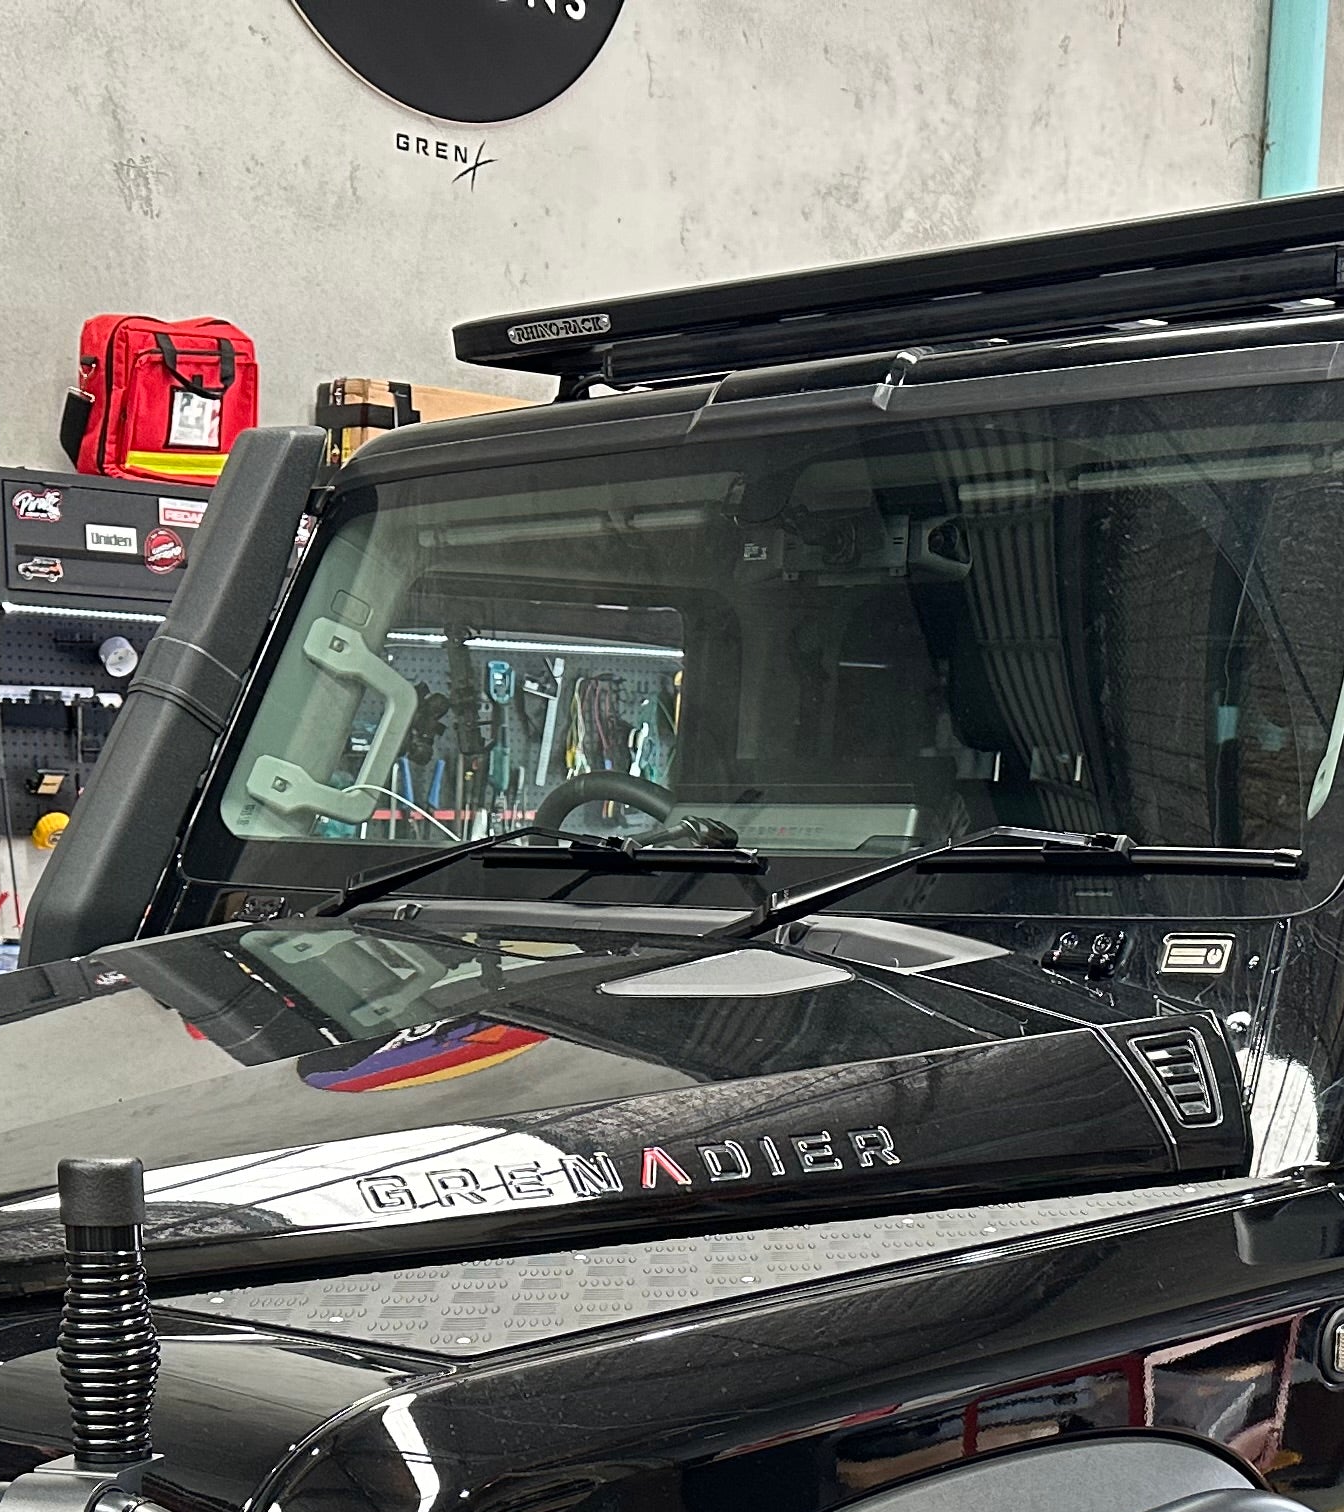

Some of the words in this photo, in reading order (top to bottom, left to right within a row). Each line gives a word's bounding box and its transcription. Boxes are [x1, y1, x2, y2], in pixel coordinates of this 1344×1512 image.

[515, 317, 603, 342] RHINO-RACK
[91, 532, 132, 547] Uniden
[357, 1126, 901, 1214] GRENADIER
